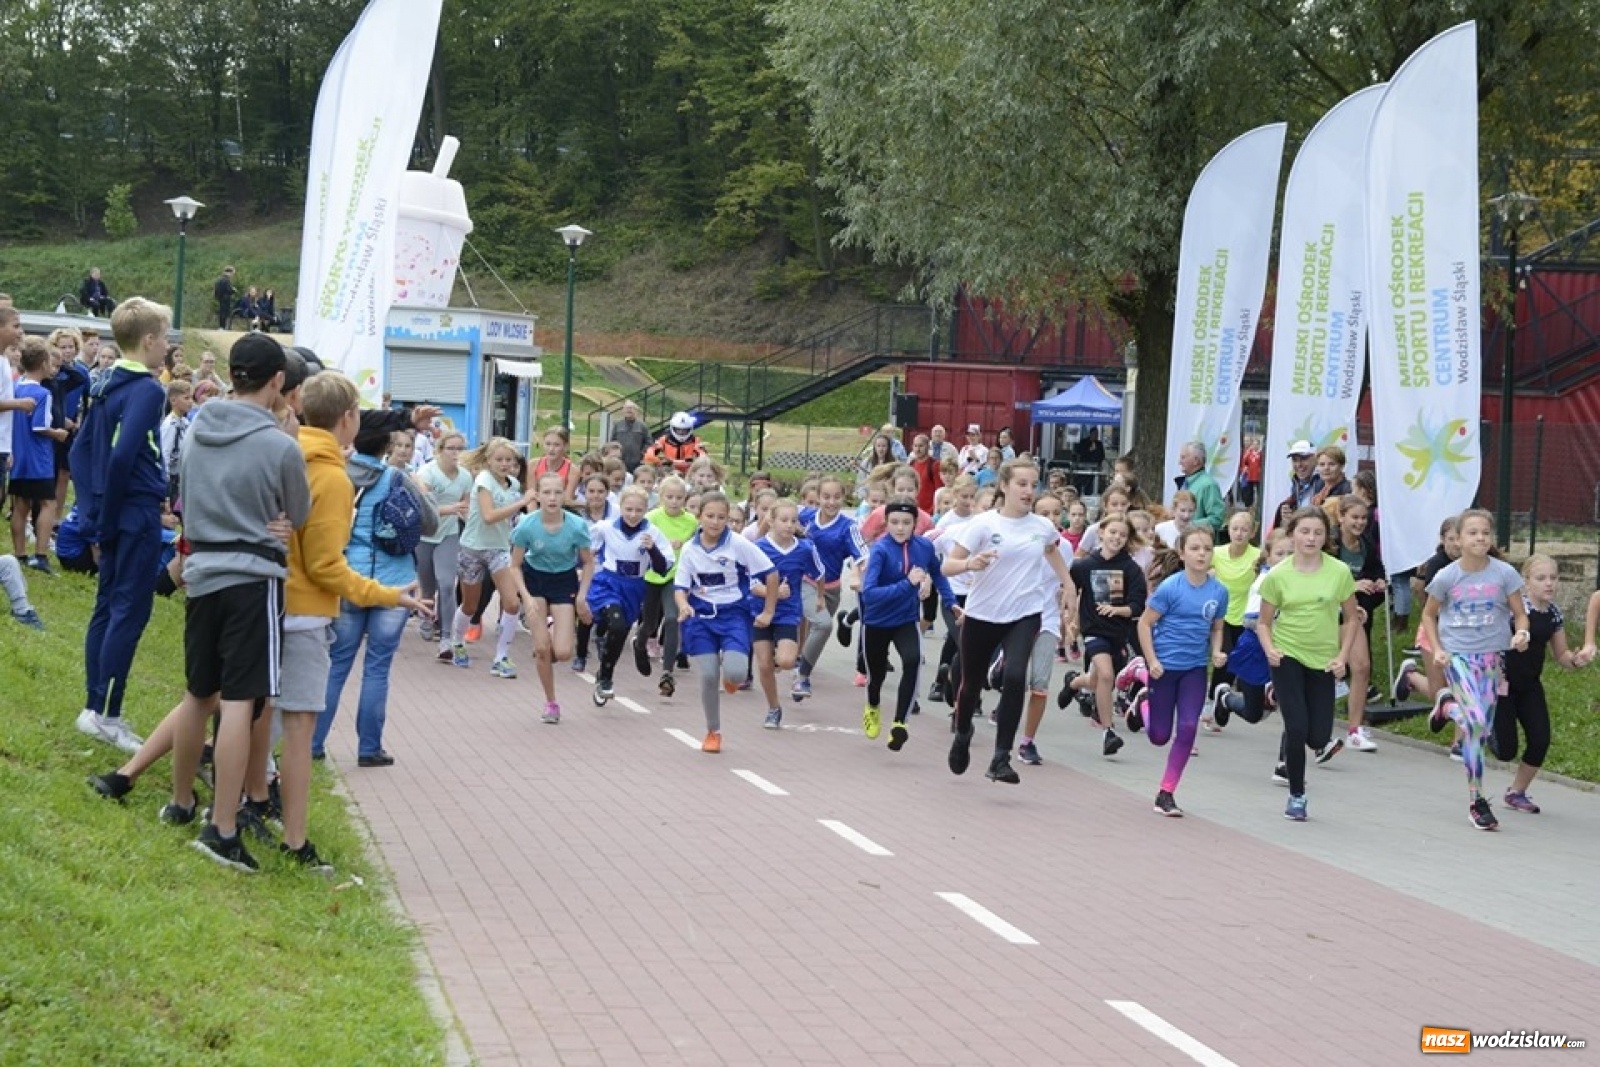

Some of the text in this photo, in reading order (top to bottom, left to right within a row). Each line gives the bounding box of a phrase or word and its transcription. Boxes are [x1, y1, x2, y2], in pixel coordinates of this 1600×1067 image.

[1209, 248, 1229, 329] REKREACJI
[1315, 223, 1336, 313] REKREACJI
[1407, 191, 1426, 293] REKREACJI
[1190, 264, 1212, 404] MIEJSKI OŚRODEK
[1236, 307, 1252, 342] Śląski
[1291, 240, 1317, 395] MIEJSKI OŚRODEK
[1340, 290, 1363, 399] Wodzisław Śląski
[1388, 214, 1412, 388] MIEJSKI OŚRODEK
[1432, 288, 1452, 386] CENTRUM
[1451, 261, 1470, 384] Wodzisław Śląski
[1217, 327, 1236, 405] CENTRUM
[1307, 327, 1327, 397] SPORTU
[1325, 311, 1345, 399] CENTRUM
[1409, 309, 1430, 388] SPORTU
